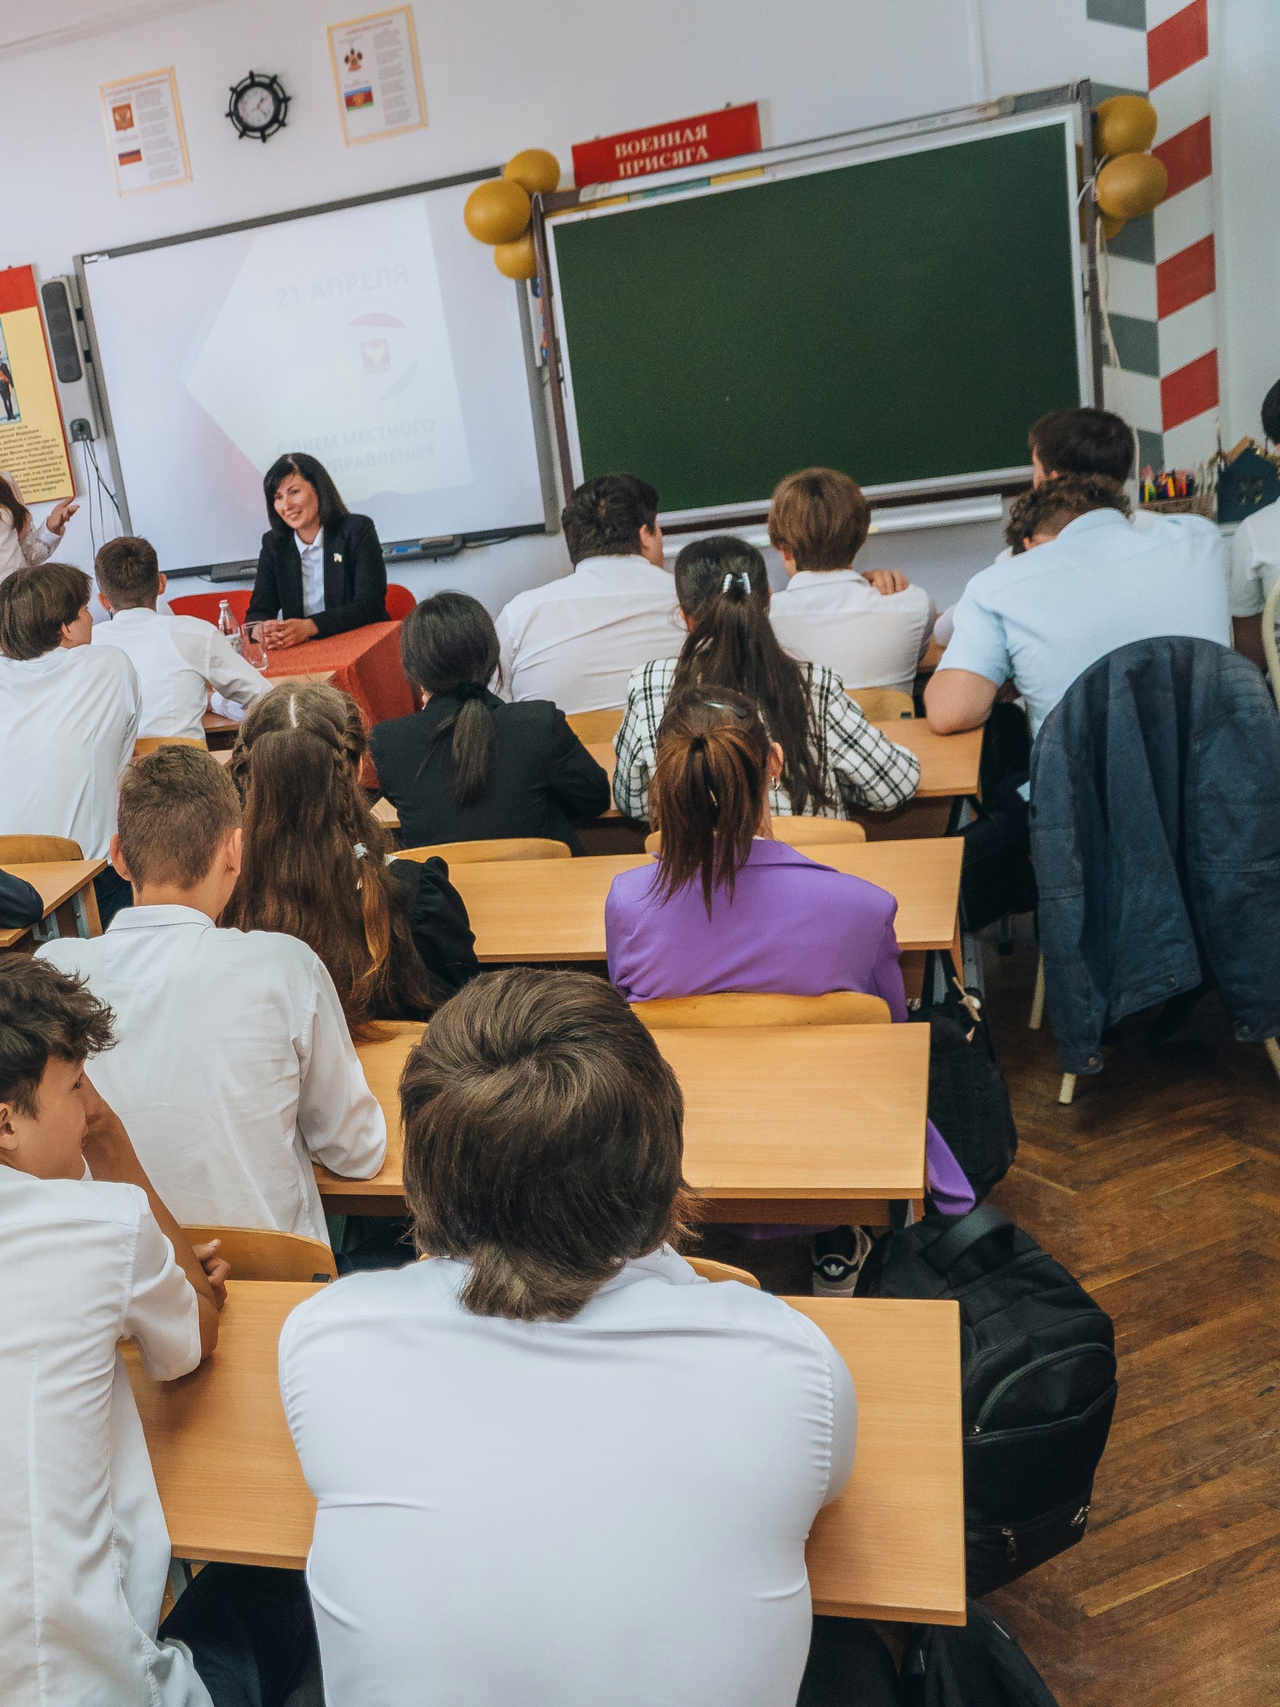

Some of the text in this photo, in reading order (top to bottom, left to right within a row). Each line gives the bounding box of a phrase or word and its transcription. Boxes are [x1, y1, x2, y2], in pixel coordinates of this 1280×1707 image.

[614, 123, 708, 159] ВОЕННАЯ
[618, 145, 709, 178] ПРИСЯГА
[276, 264, 409, 308] 21 АПРЕЛЯ
[342, 417, 436, 446] МЕСТНОГО
